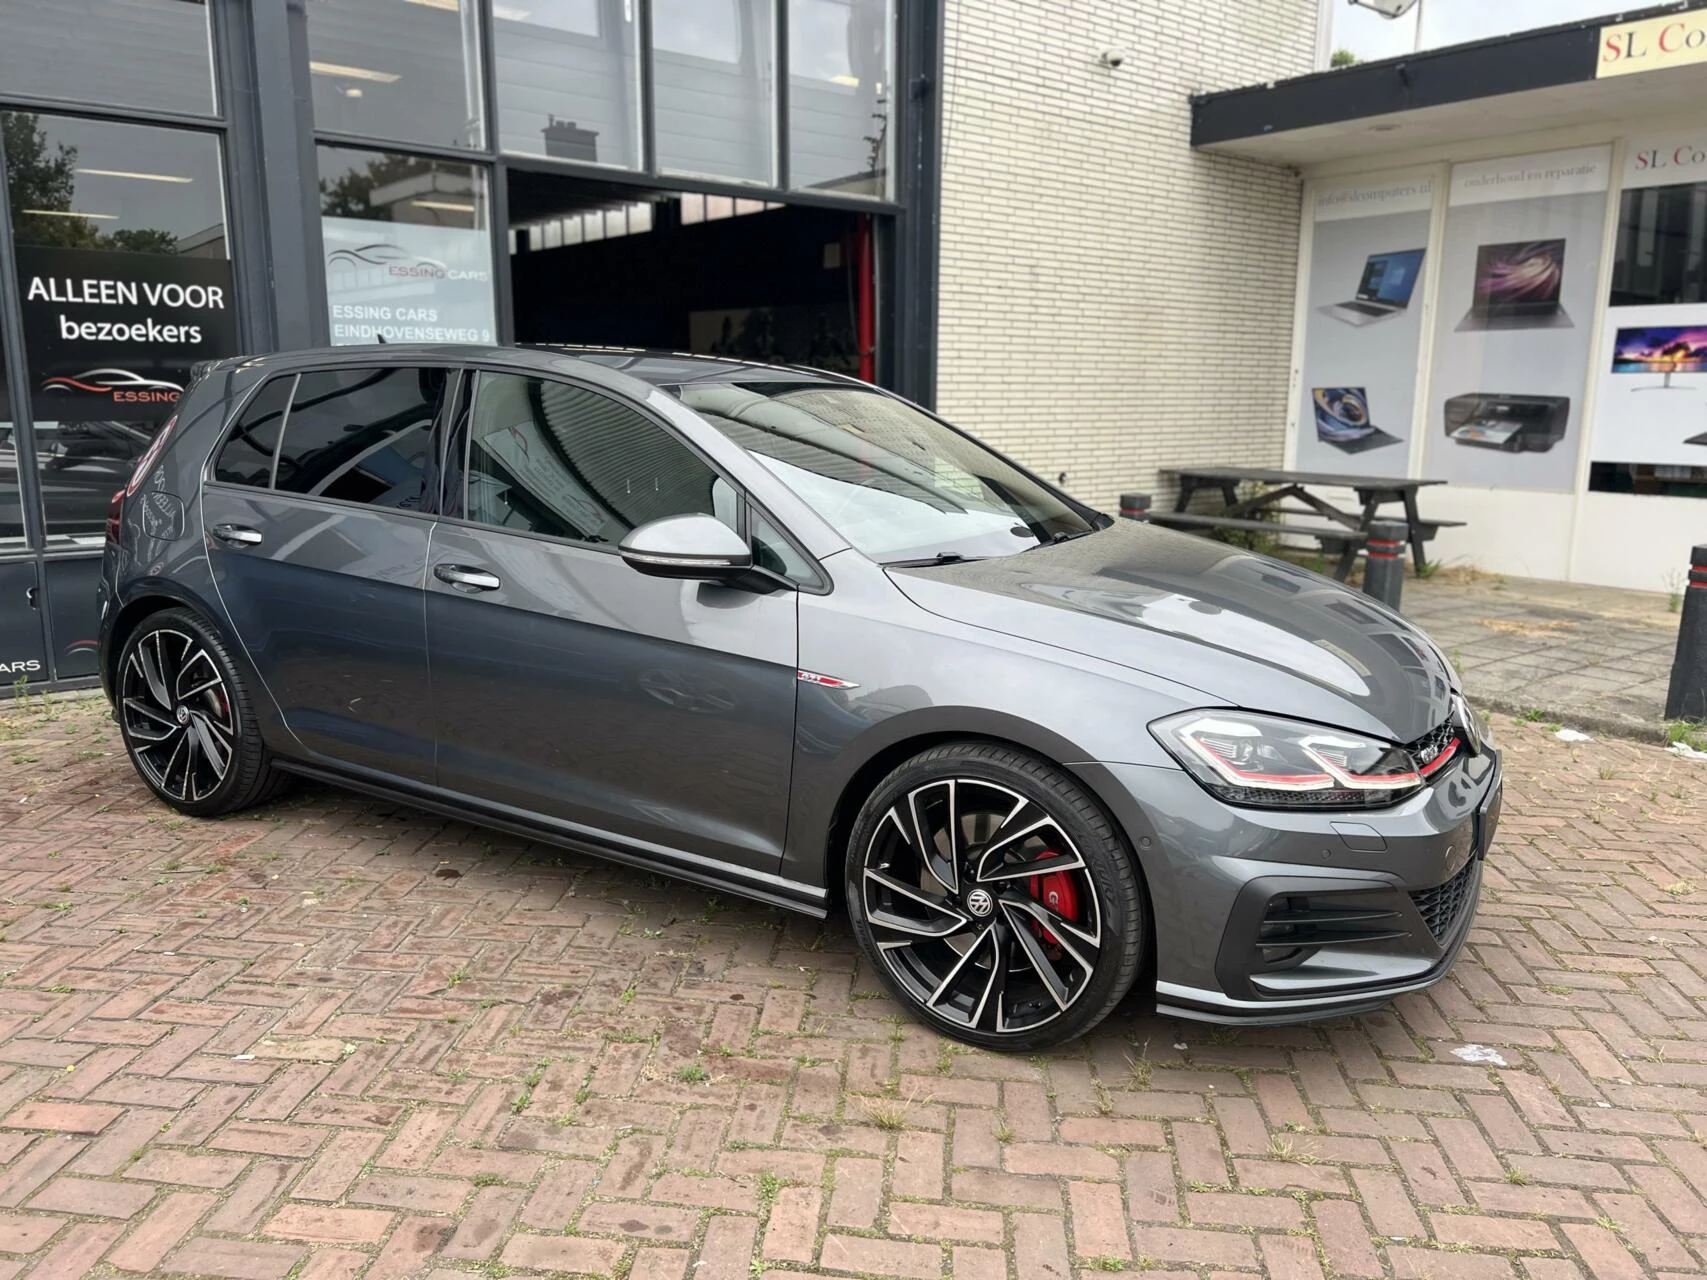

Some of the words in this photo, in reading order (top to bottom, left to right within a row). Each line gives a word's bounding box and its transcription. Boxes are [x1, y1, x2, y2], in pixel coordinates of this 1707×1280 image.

[1602, 31, 1648, 62] SL
[1635, 149, 1667, 171] SL
[388, 265, 446, 279] ESSING
[447, 270, 489, 283] CARS
[27, 276, 139, 306] ALLEEN
[142, 282, 225, 310] VOOR
[332, 305, 392, 321] ESSING
[395, 308, 438, 323] CARS
[59, 314, 202, 344] bezoekers
[334, 324, 478, 342] EINDHOVENSEWEG
[482, 329, 491, 343] 9
[113, 391, 181, 403] ESSING
